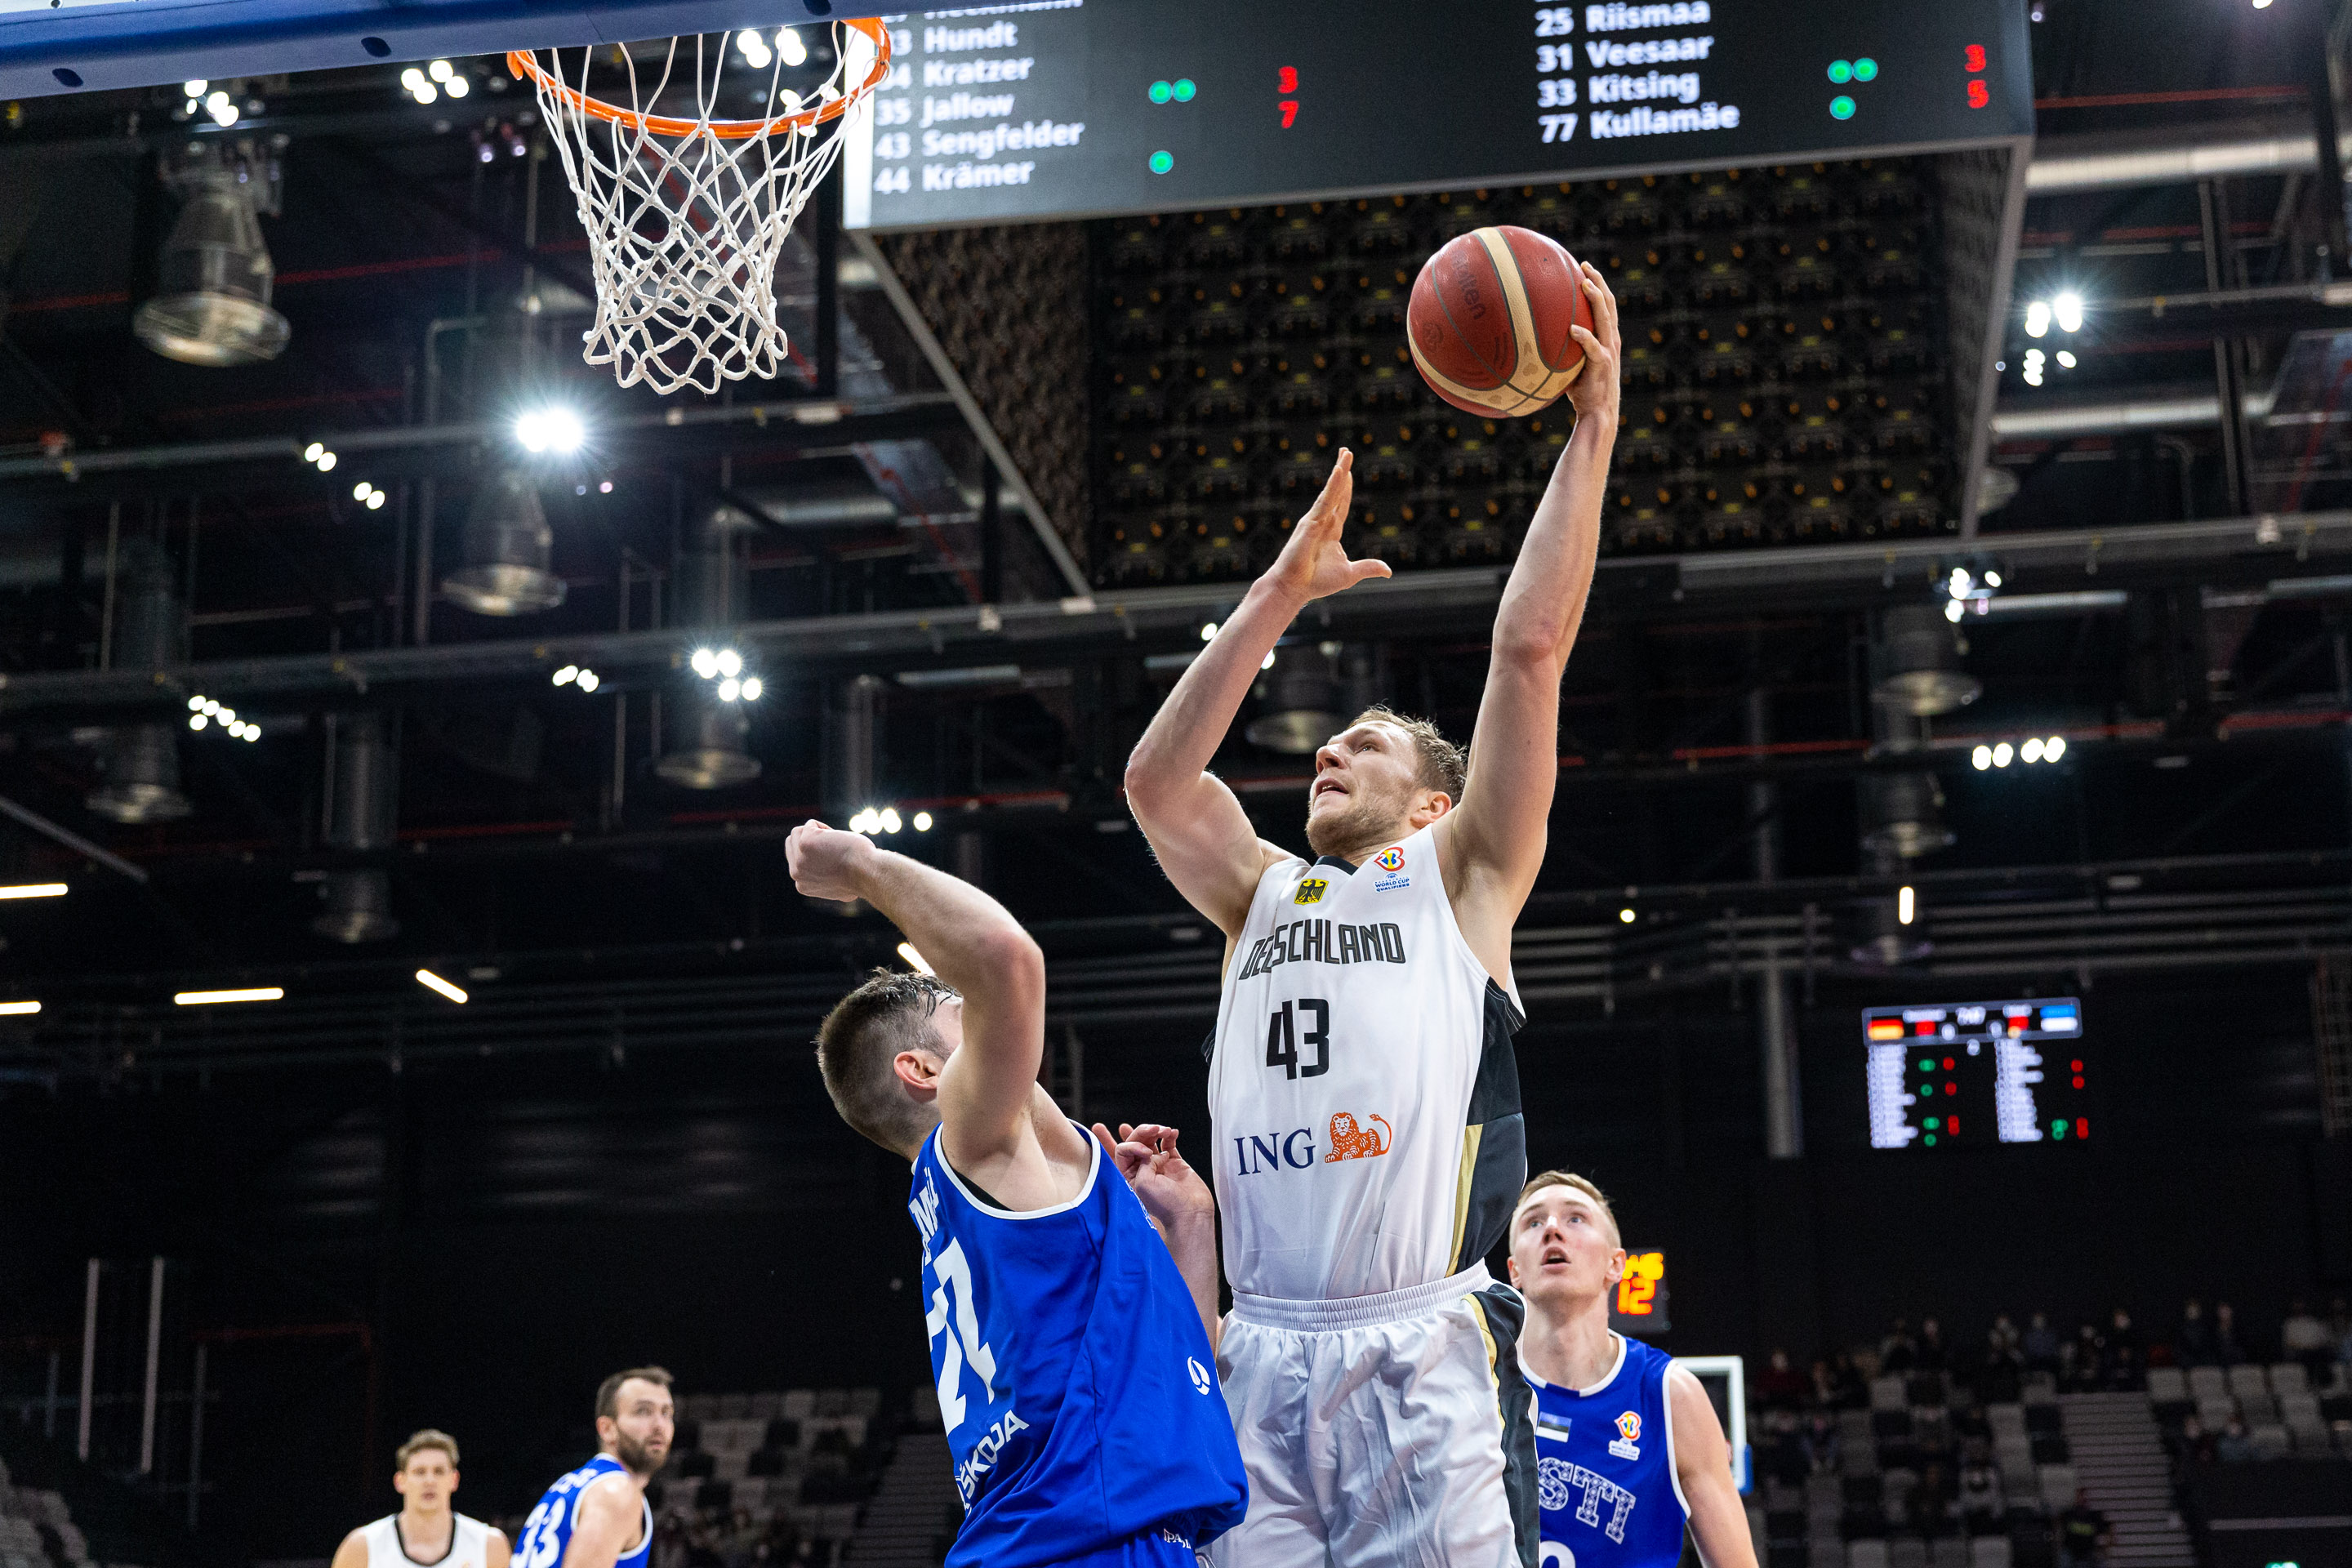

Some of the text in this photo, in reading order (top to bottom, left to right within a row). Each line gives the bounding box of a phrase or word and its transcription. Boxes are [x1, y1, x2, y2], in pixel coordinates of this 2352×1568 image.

[924, 20, 1018, 54] Hundt
[1535, 1, 1711, 37] 25 Riismaa
[924, 56, 1035, 87] Kratzer
[1535, 35, 1715, 73] 31 Veesaar
[1537, 44, 1986, 108] 33 Kitsing 3
[875, 66, 1298, 128] 35 Jallow 3
[1538, 79, 1989, 144] 77 Kullamäe 5
[874, 100, 1299, 159] 43 Sengfelder 7
[873, 160, 1036, 194] 44 Krämer
[1375, 883, 1410, 892] QUALIFIERS
[1266, 998, 1330, 1080] 43
[1234, 1127, 1316, 1176] ING
[1617, 1276, 1656, 1315] 12
[1538, 1458, 1637, 1545] STI
